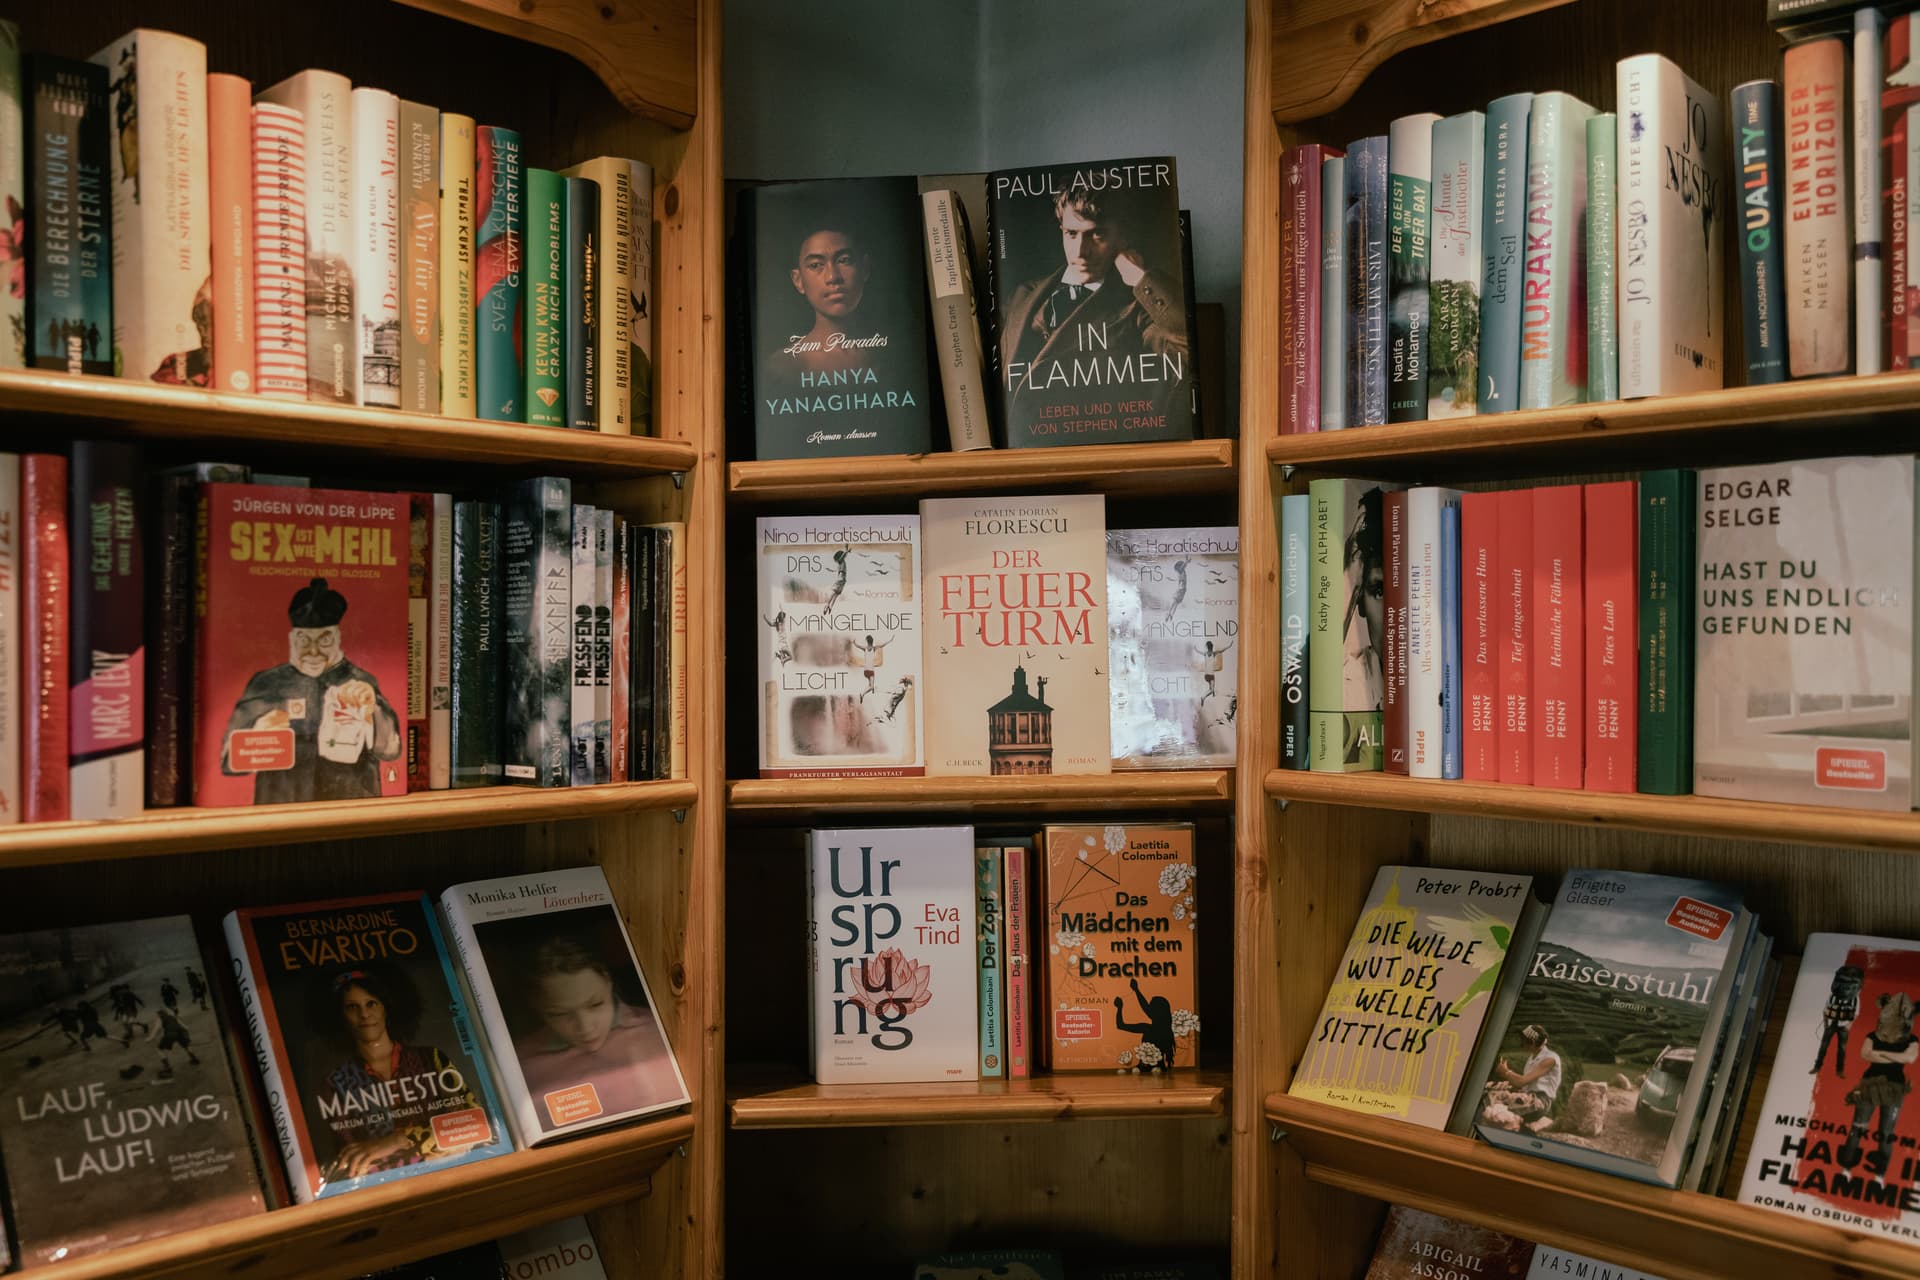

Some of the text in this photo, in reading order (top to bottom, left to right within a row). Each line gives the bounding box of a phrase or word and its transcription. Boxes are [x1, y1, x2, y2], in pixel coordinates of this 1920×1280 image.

[1747, 100, 1758, 123] TIME
[1790, 87, 1812, 223] EIN NEUER
[1814, 82, 1838, 217] HORIZONT
[45, 133, 70, 265] BERECHNUNG
[996, 164, 1171, 200] PAUL AUSTER
[1741, 127, 1771, 253] QUALITY
[78, 163, 101, 278] DER STERNE
[380, 119, 398, 311] Der andere Mann
[507, 141, 520, 288] GEWITTERTIERE
[1392, 180, 1403, 253] DER GEIST
[1403, 210, 1411, 229] VON
[1411, 185, 1426, 259] TIGER BAY
[491, 140, 507, 332] SVEALENA KUTSCHKE
[1892, 178, 1906, 316] GRAHAM NORTON
[414, 212, 435, 337] Wir für uns
[1523, 161, 1554, 361] MURAKAMI
[1802, 243, 1812, 309] MAIKEN
[1816, 238, 1827, 310] NIELSEN
[52, 272, 70, 297] DIE
[324, 257, 337, 330] MICHAELA
[549, 201, 560, 378] CRAZY RICH PROBLEMS
[1440, 283, 1449, 330] SARAH
[536, 282, 548, 376] KEVIN KWAN
[783, 331, 888, 358] Zum Paradies
[1077, 322, 1108, 352] IN
[1408, 311, 1420, 381] Mohamed
[800, 367, 879, 388] HANYA
[1007, 351, 1183, 392] FLAMMEN
[1393, 338, 1403, 382] Nadifa
[765, 390, 916, 416] YANAGIHARA
[1039, 400, 1154, 419] LEBEN UND WERK
[1028, 416, 1168, 435] VON STEPHEN CRANE
[232, 497, 396, 521] JÜRGEN VON DER LIPPE
[1704, 478, 1792, 502] EDGAR
[764, 525, 912, 544] Nino Haratischwili
[965, 518, 1069, 536] FLORESCU
[1318, 498, 1328, 565] ALPHABET
[1704, 507, 1781, 528] SELGE
[229, 520, 397, 566] SEX IST MEHL
[992, 549, 1043, 569] DER
[787, 555, 822, 573] DAS
[1286, 532, 1297, 598] Vorleben
[1703, 559, 1817, 581] HAST DU
[480, 577, 490, 618] LYNCH
[938, 571, 1098, 611] FEUER
[1318, 575, 1330, 633] Kathy Page
[1411, 564, 1420, 655] ANNETTE PEHNT
[1476, 547, 1487, 664] Das verlassene Haus
[1703, 589, 1754, 608] UNS
[789, 613, 913, 632] MANGELNDE
[942, 609, 1096, 648] TURM
[1549, 559, 1562, 668] Heimliche Fährten
[1602, 600, 1615, 666] Totes Laub
[1702, 616, 1852, 636] GEFUNDEN
[480, 620, 490, 651] PAUL
[574, 604, 592, 687] FRESSFEIND
[1287, 614, 1302, 704] OSWALD
[1385, 607, 1396, 705] drei Sprachen bellen
[782, 672, 849, 691] LICHT
[1472, 694, 1480, 732] LOUISE
[1482, 695, 1491, 732] PENNY
[1507, 694, 1516, 732] LOUISE
[1517, 695, 1527, 733] PENNY
[1545, 699, 1555, 738] LOUISE
[1556, 700, 1566, 738] PENNY
[1598, 698, 1607, 738] LOUISE
[1608, 699, 1618, 738] PENNY
[1285, 724, 1294, 758] PIPER
[1415, 730, 1425, 765] PIPER
[1121, 850, 1178, 861] Colombani
[1130, 839, 1170, 850] Laetitia
[828, 846, 901, 898] Ur
[1415, 877, 1523, 899] Peter Probst
[1571, 877, 1627, 894] Brigitte
[467, 882, 559, 906] Monika Helfer
[924, 903, 960, 922] Eva
[1115, 892, 1148, 906] Das
[1565, 891, 1616, 907] Glaser
[286, 909, 399, 939] BERNARDINE
[830, 902, 902, 954] sp
[914, 926, 960, 945] Tind
[981, 895, 1000, 969] Der Zopf
[1010, 879, 1021, 977] Das Haus der Frauen
[1060, 911, 1170, 934] Mädchen
[279, 927, 418, 971] EVARISTO
[1110, 936, 1183, 953] mit dem
[1367, 921, 1482, 965] DIE WILDE
[832, 957, 896, 993] ru
[1078, 956, 1178, 978] Drachen
[1347, 956, 1444, 992] WUT DES
[1528, 951, 1716, 1005] Kaiserstuhl
[833, 998, 914, 1051] ng
[1355, 987, 1460, 1026] WELLEN-
[1612, 998, 1648, 1013] Roman
[1318, 1016, 1435, 1055] SITTICHS
[17, 1083, 113, 1121] LAUF,
[316, 1067, 465, 1120] MANIFESTO
[84, 1094, 229, 1143] LUDWIG,
[55, 1140, 156, 1183] LAUF!
[1753, 1195, 1807, 1214] ROMAN
[1811, 1207, 1874, 1229] OSBURG
[1408, 1240, 1485, 1273] ABIGAIL
